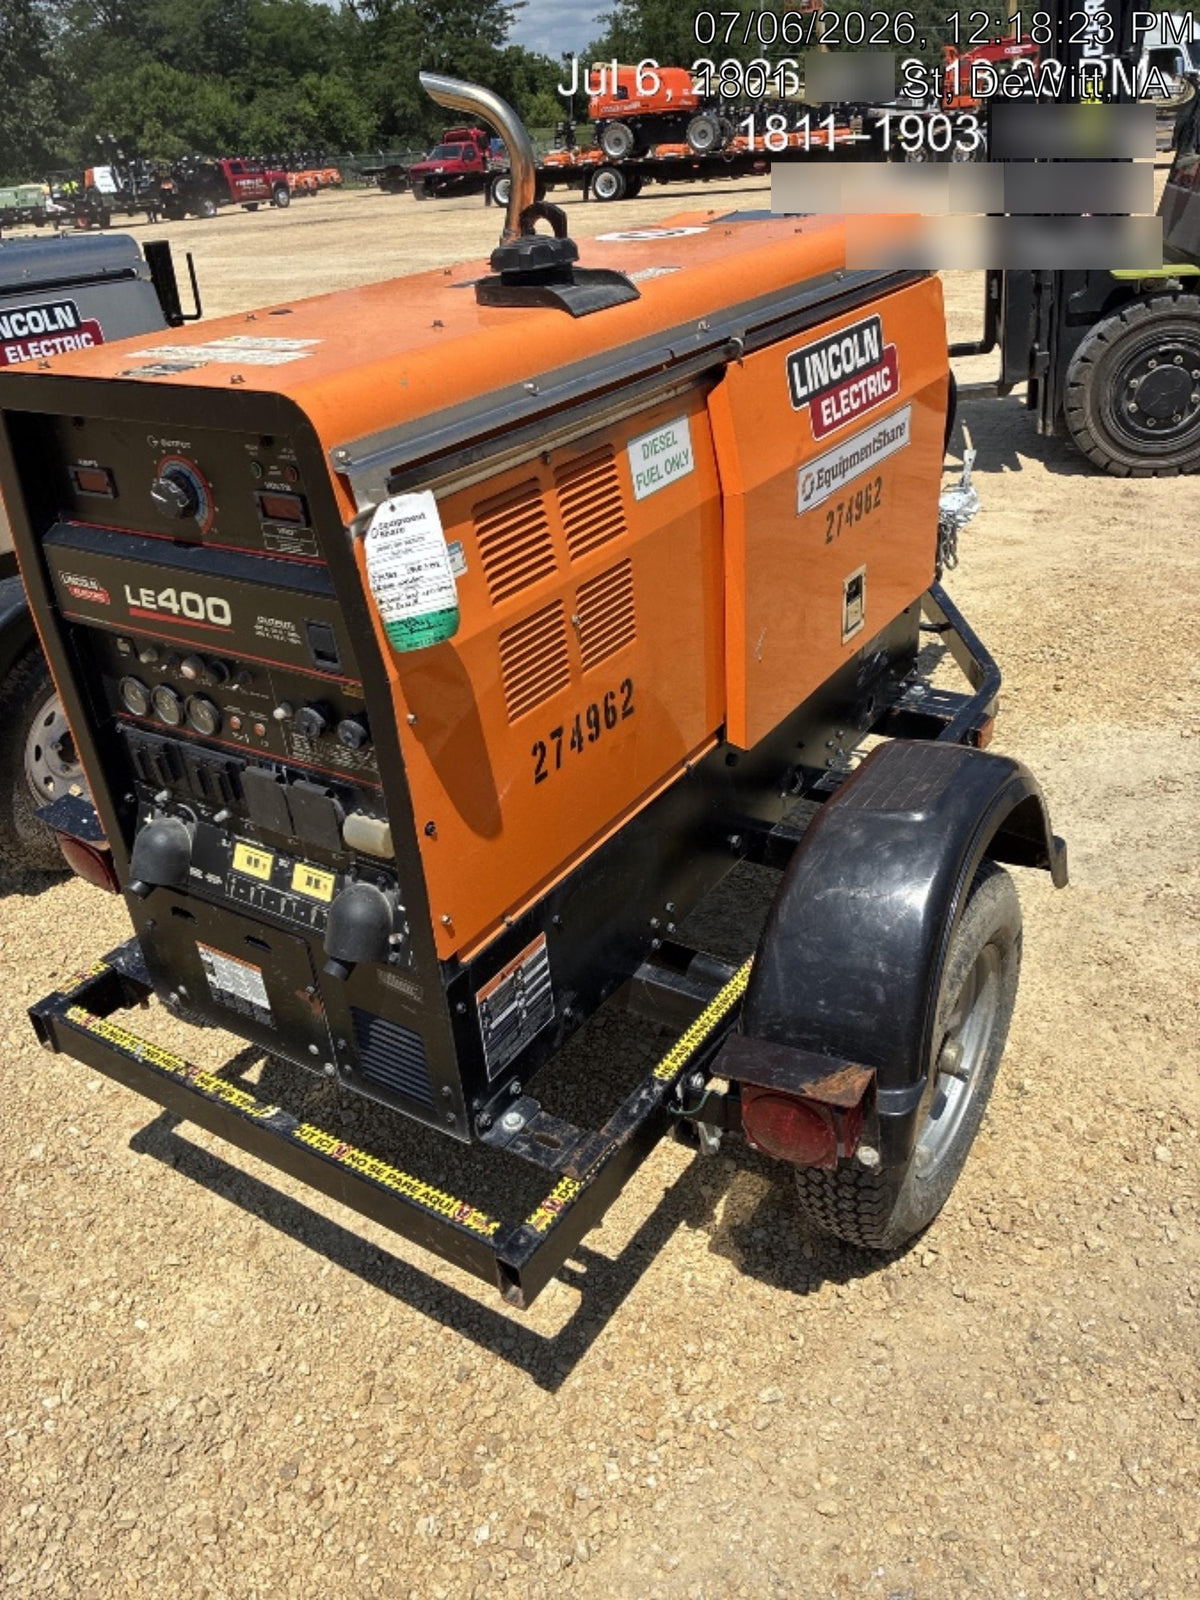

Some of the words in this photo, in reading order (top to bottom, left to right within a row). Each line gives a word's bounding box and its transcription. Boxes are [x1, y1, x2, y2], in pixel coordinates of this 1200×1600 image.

[5, 331, 96, 364] ELECTRIC
[793, 324, 880, 399] LINCOLN
[820, 366, 892, 427] ELECTRIC
[635, 463, 664, 491] FUEL
[664, 447, 689, 476] ONLY
[641, 430, 678, 461] DIESEL
[815, 421, 907, 491] EquipmentShare
[825, 475, 882, 545] 274962
[123, 584, 233, 626] LE400
[530, 677, 635, 785] 274962
[346, 1151, 367, 1168] NO
[367, 1162, 385, 1176] SE
[385, 1170, 421, 1194] PARE
[420, 1188, 453, 1211] AQUI
